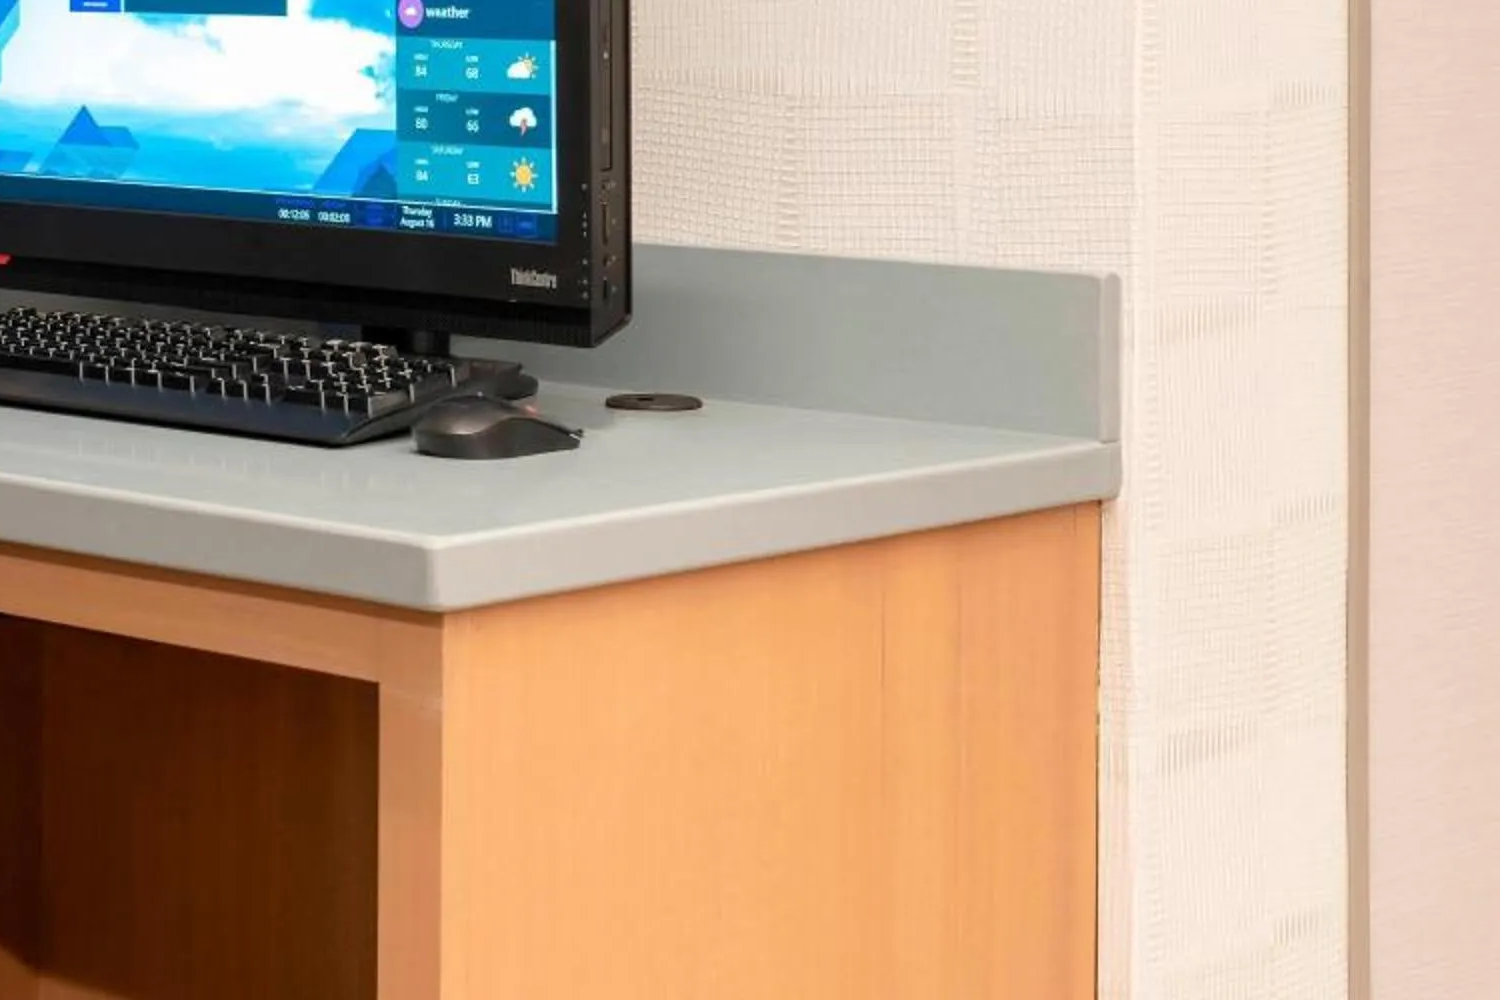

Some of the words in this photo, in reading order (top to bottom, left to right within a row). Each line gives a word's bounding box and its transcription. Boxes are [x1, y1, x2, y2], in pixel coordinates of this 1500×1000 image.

[425, 5, 469, 19] weather
[402, 205, 433, 219] Thursday
[399, 216, 425, 229] August
[453, 212, 474, 227] 3:33
[475, 215, 493, 229] PM
